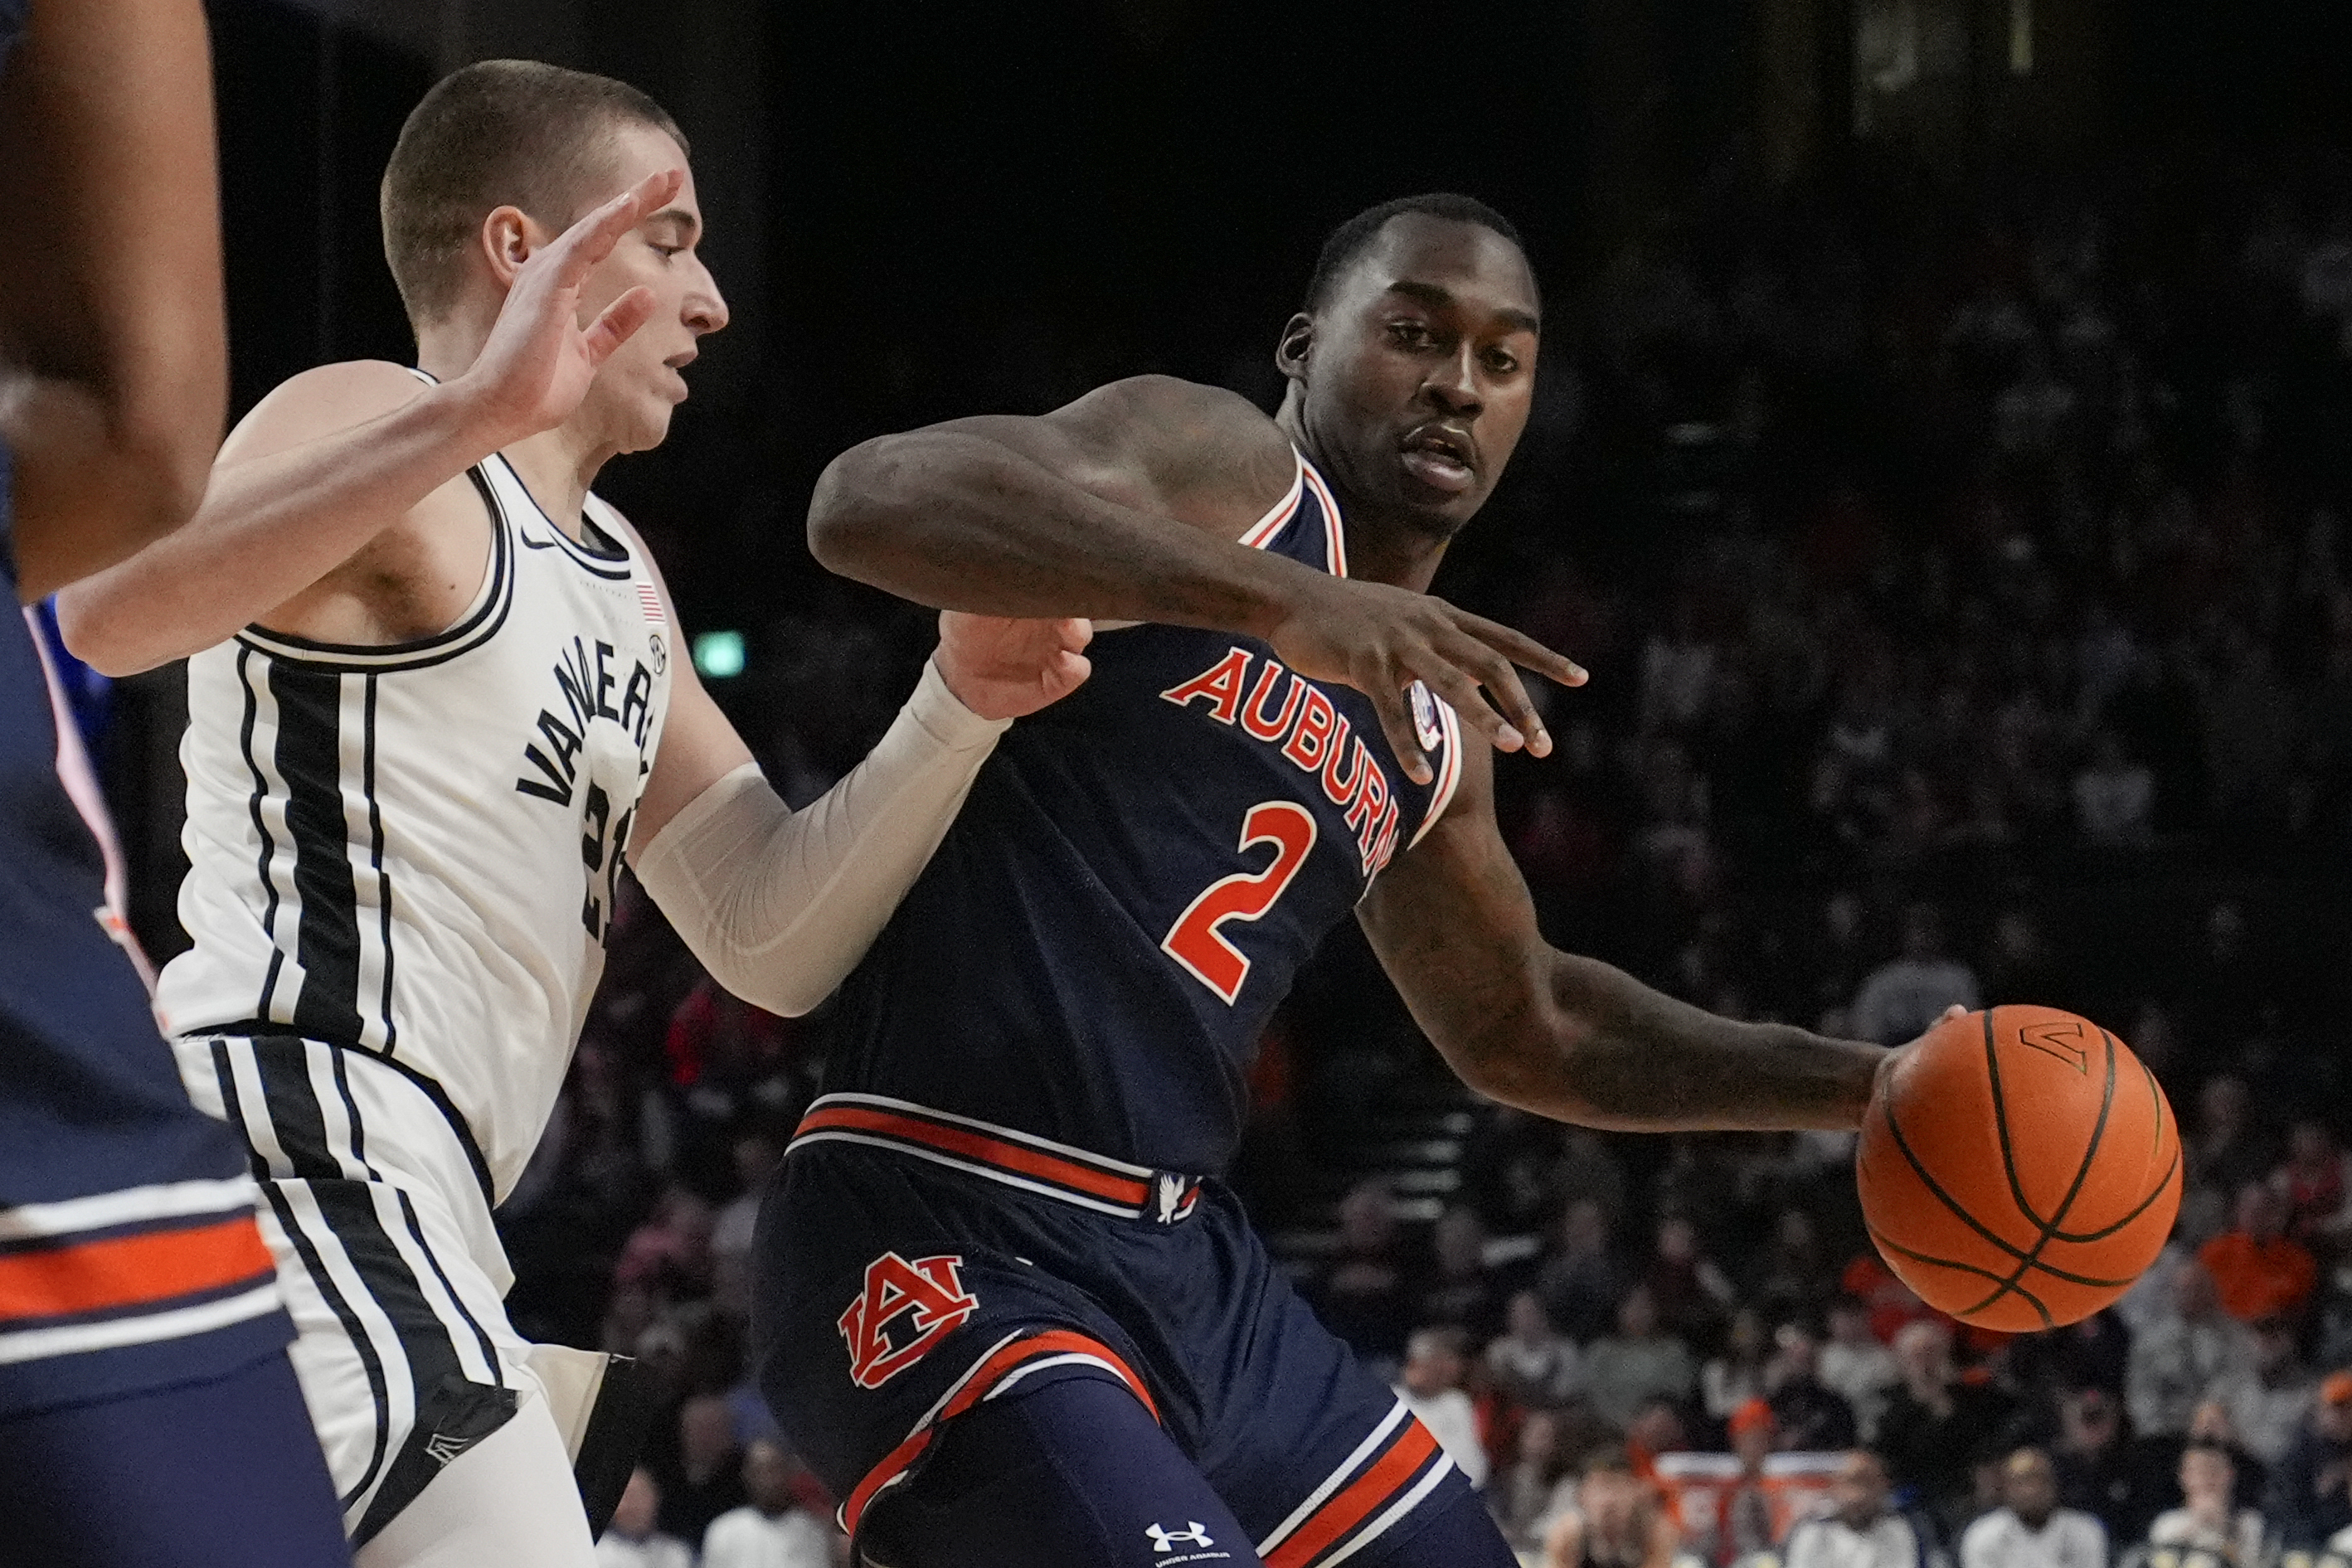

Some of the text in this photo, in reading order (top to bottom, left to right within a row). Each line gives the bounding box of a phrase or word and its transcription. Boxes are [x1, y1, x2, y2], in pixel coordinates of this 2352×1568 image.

[1159, 646, 1400, 877] AUBURN
[1161, 800, 1318, 1007] 2
[1154, 1556, 1188, 1568] UNDER
